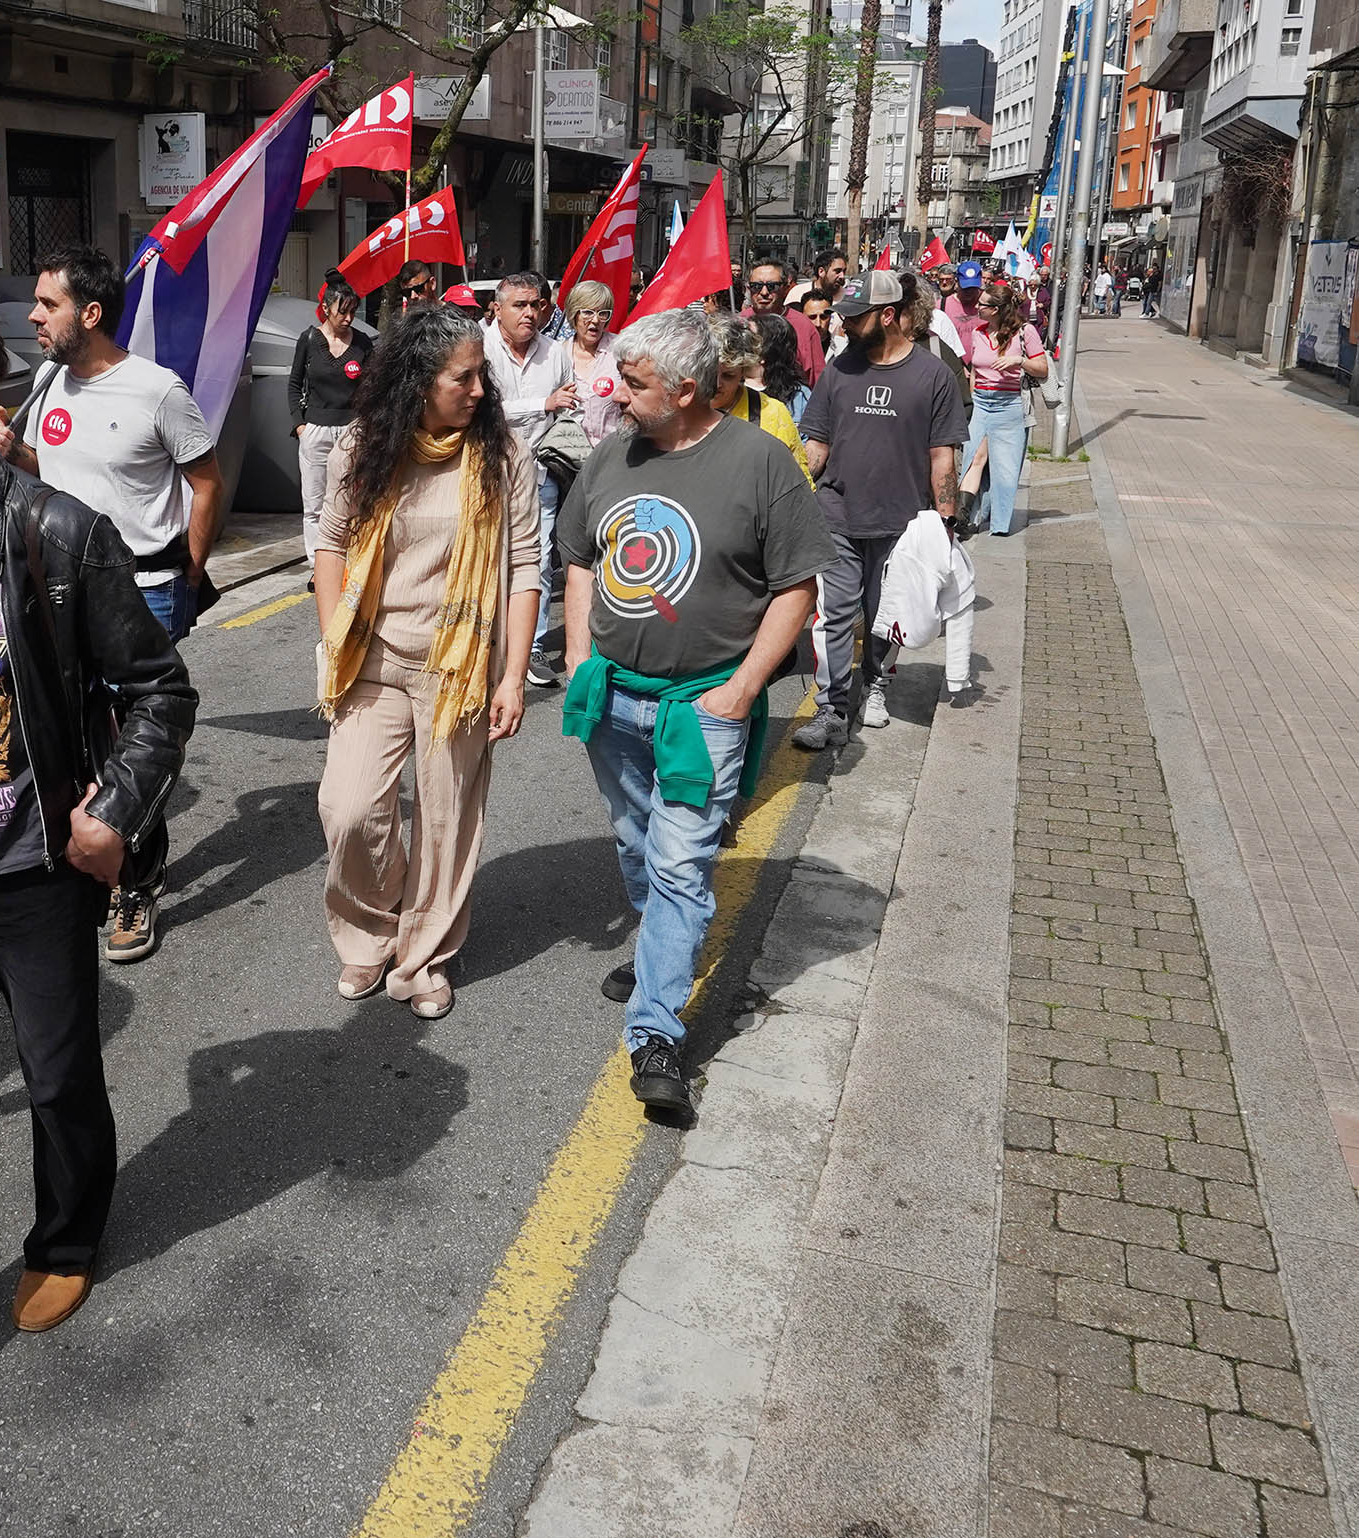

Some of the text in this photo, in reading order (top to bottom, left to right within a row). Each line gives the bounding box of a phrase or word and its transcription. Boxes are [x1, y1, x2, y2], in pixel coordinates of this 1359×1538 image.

[150, 185, 172, 195] AGENCIA
[173, 185, 180, 194] DE
[854, 406, 899, 417] HONDA
[48, 414, 67, 433] CIG
